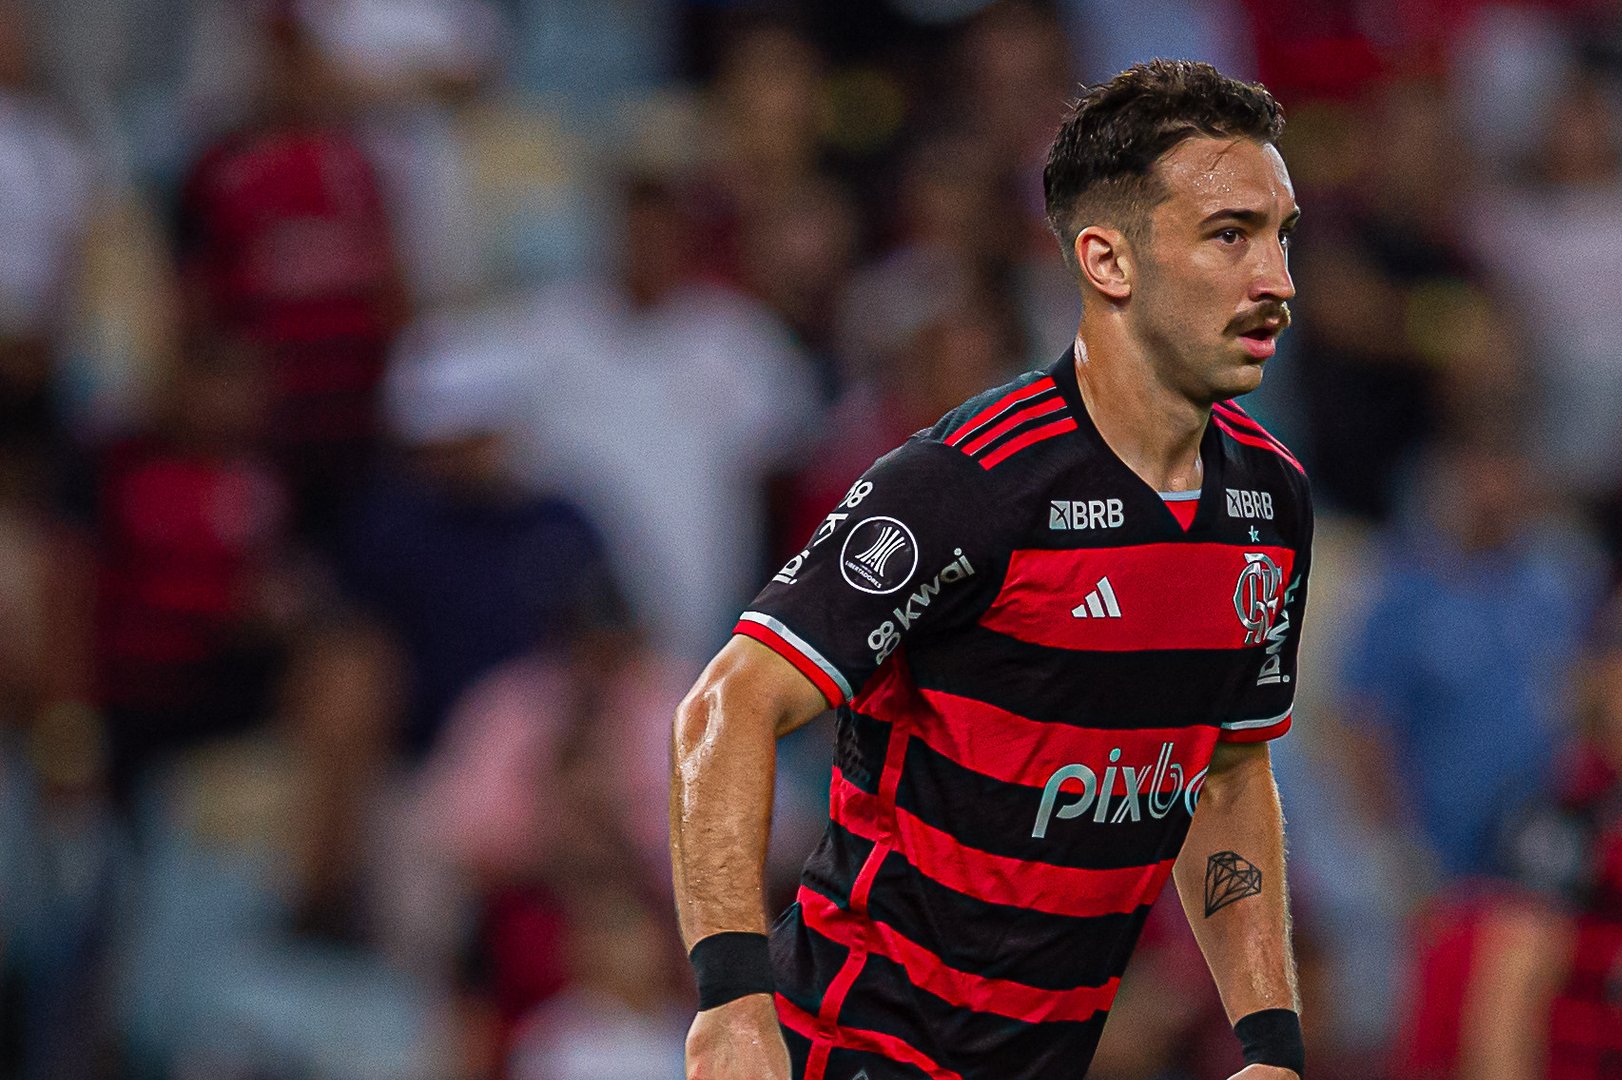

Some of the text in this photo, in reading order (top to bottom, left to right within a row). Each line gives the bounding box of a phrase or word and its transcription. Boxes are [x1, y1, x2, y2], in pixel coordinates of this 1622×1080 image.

[1072, 499, 1125, 530] BRB
[1241, 490, 1274, 520] BRB
[845, 560, 882, 589] LIBERTADORES
[893, 547, 976, 630] kwai
